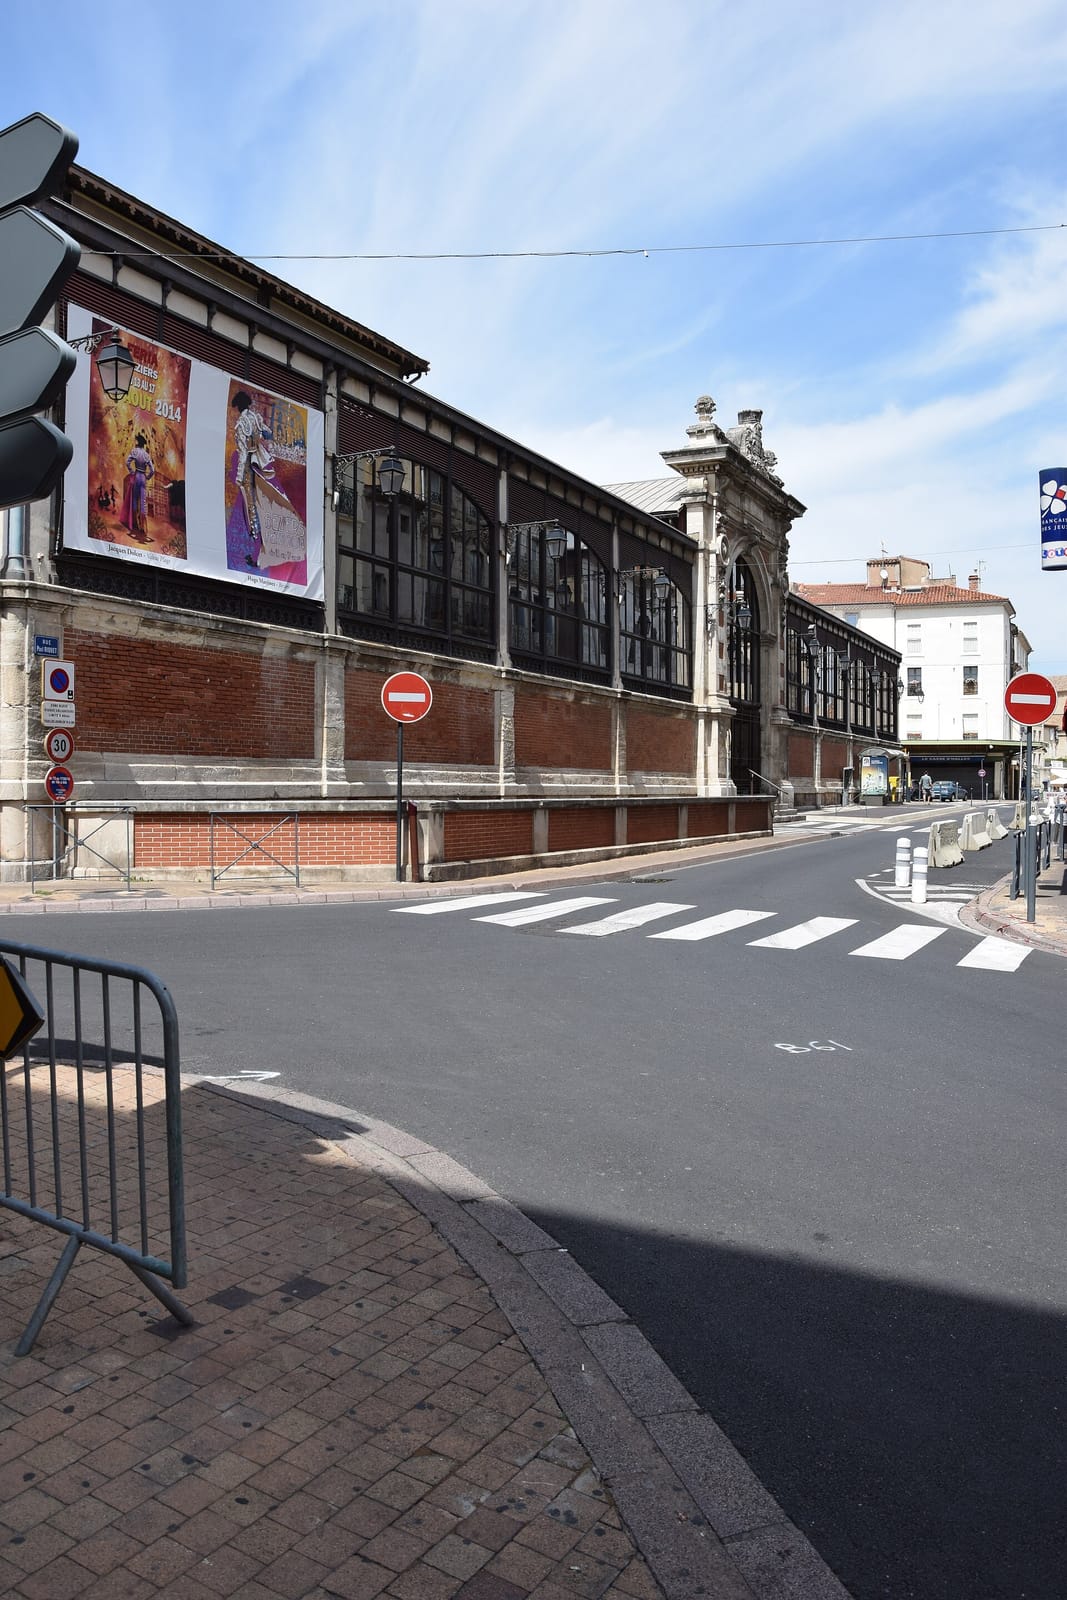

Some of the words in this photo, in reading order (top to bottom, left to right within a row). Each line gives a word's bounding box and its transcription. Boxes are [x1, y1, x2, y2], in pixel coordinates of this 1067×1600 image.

[134, 363, 158, 380] ZIERS
[134, 377, 141, 389] 13
[141, 381, 148, 391] AU
[149, 383, 155, 394] 17
[156, 399, 181, 422] 2014
[54, 739, 66, 752] 30
